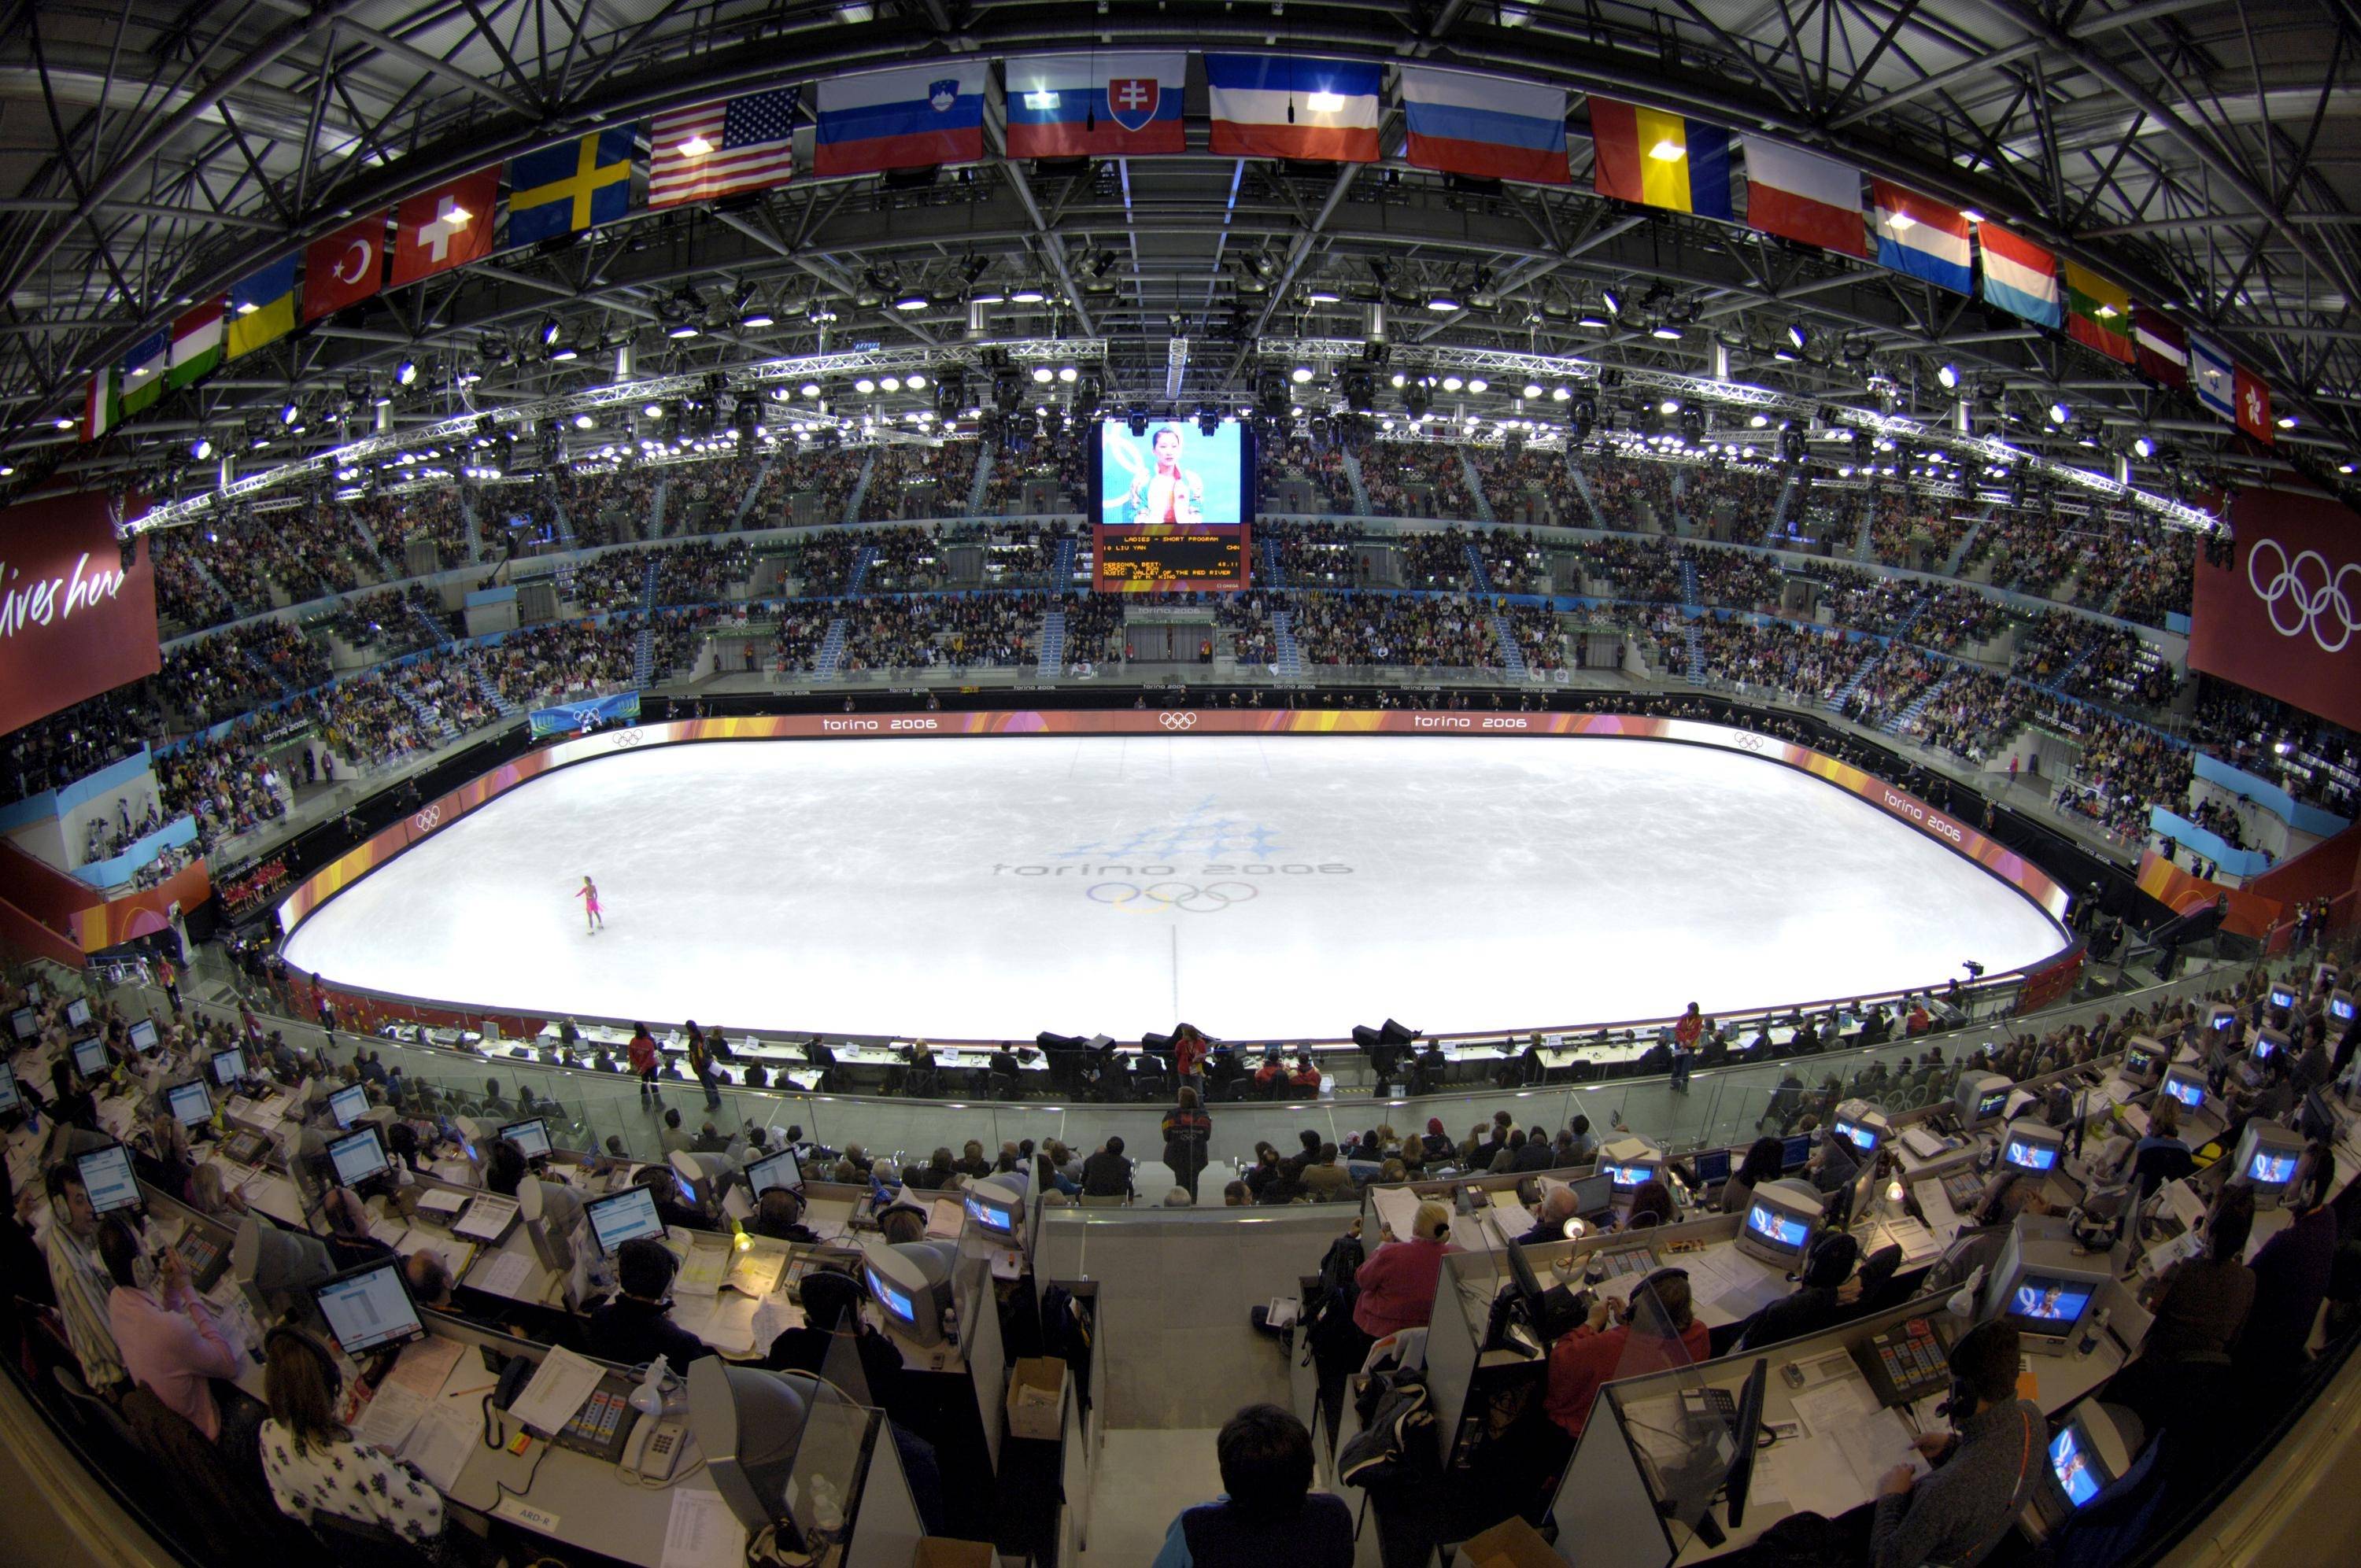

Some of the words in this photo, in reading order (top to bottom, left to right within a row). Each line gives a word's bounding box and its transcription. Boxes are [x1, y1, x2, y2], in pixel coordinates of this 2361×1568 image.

[823, 719, 878, 730] torino
[890, 719, 938, 729] 2006
[1415, 715, 1471, 727] torino
[1482, 718, 1527, 728] 2006
[2035, 711, 2060, 725] torino
[2060, 721, 2081, 735] 2006
[263, 726, 288, 743] torino
[289, 719, 309, 732] 2006
[1884, 789, 1922, 819] torino
[1927, 815, 1960, 842] 2006
[992, 863, 1176, 877] torino
[1202, 863, 1354, 875] 2006
[519, 1509, 550, 1526] ARD-R
